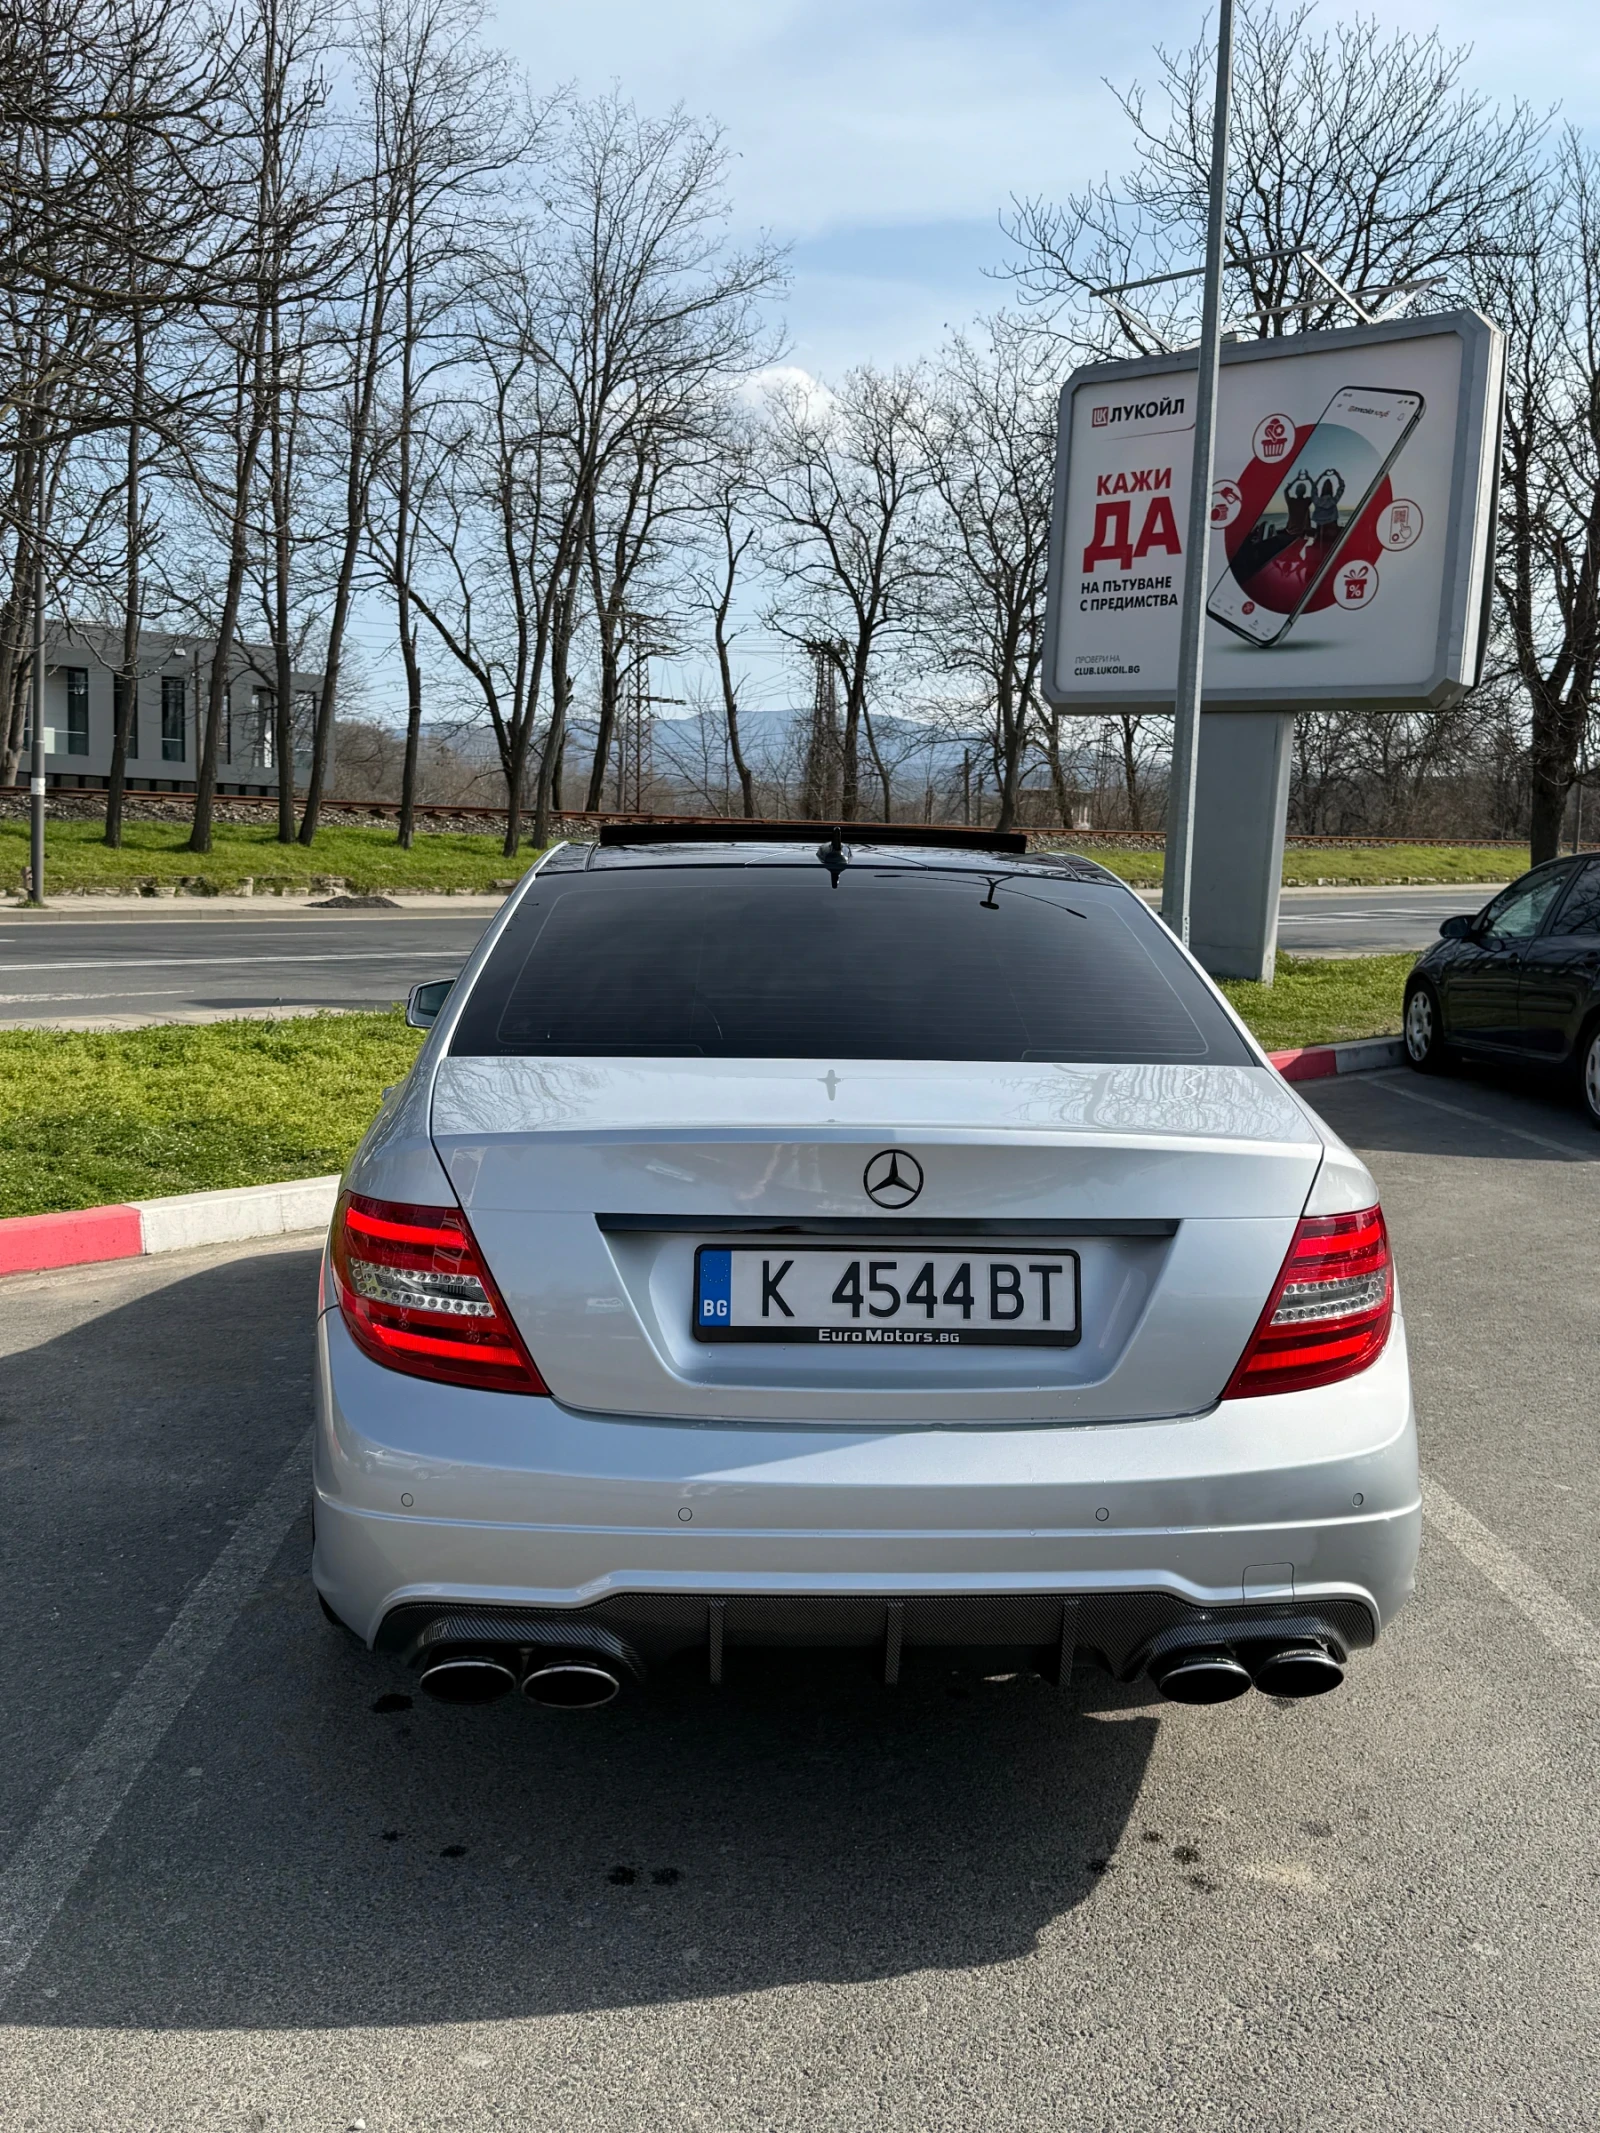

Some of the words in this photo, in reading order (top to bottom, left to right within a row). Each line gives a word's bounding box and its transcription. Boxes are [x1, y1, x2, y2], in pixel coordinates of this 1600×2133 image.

[1109, 397, 1185, 423] ЛУКОЙЛ
[1096, 467, 1172, 496] КАЖИ
[1082, 496, 1182, 573] ДА
[1081, 582, 1100, 594] НА
[1102, 576, 1172, 593] ПЪТУВАНЕ
[1080, 600, 1088, 612] С
[1090, 593, 1178, 612] ПРЕДИМСТВА
[1075, 655, 1109, 664] ПРОВЕРИ
[1110, 654, 1121, 662] НА
[1074, 665, 1140, 676] CLUB.LUKOIL.BG
[761, 1260, 795, 1318] K
[703, 1299, 728, 1317] BG
